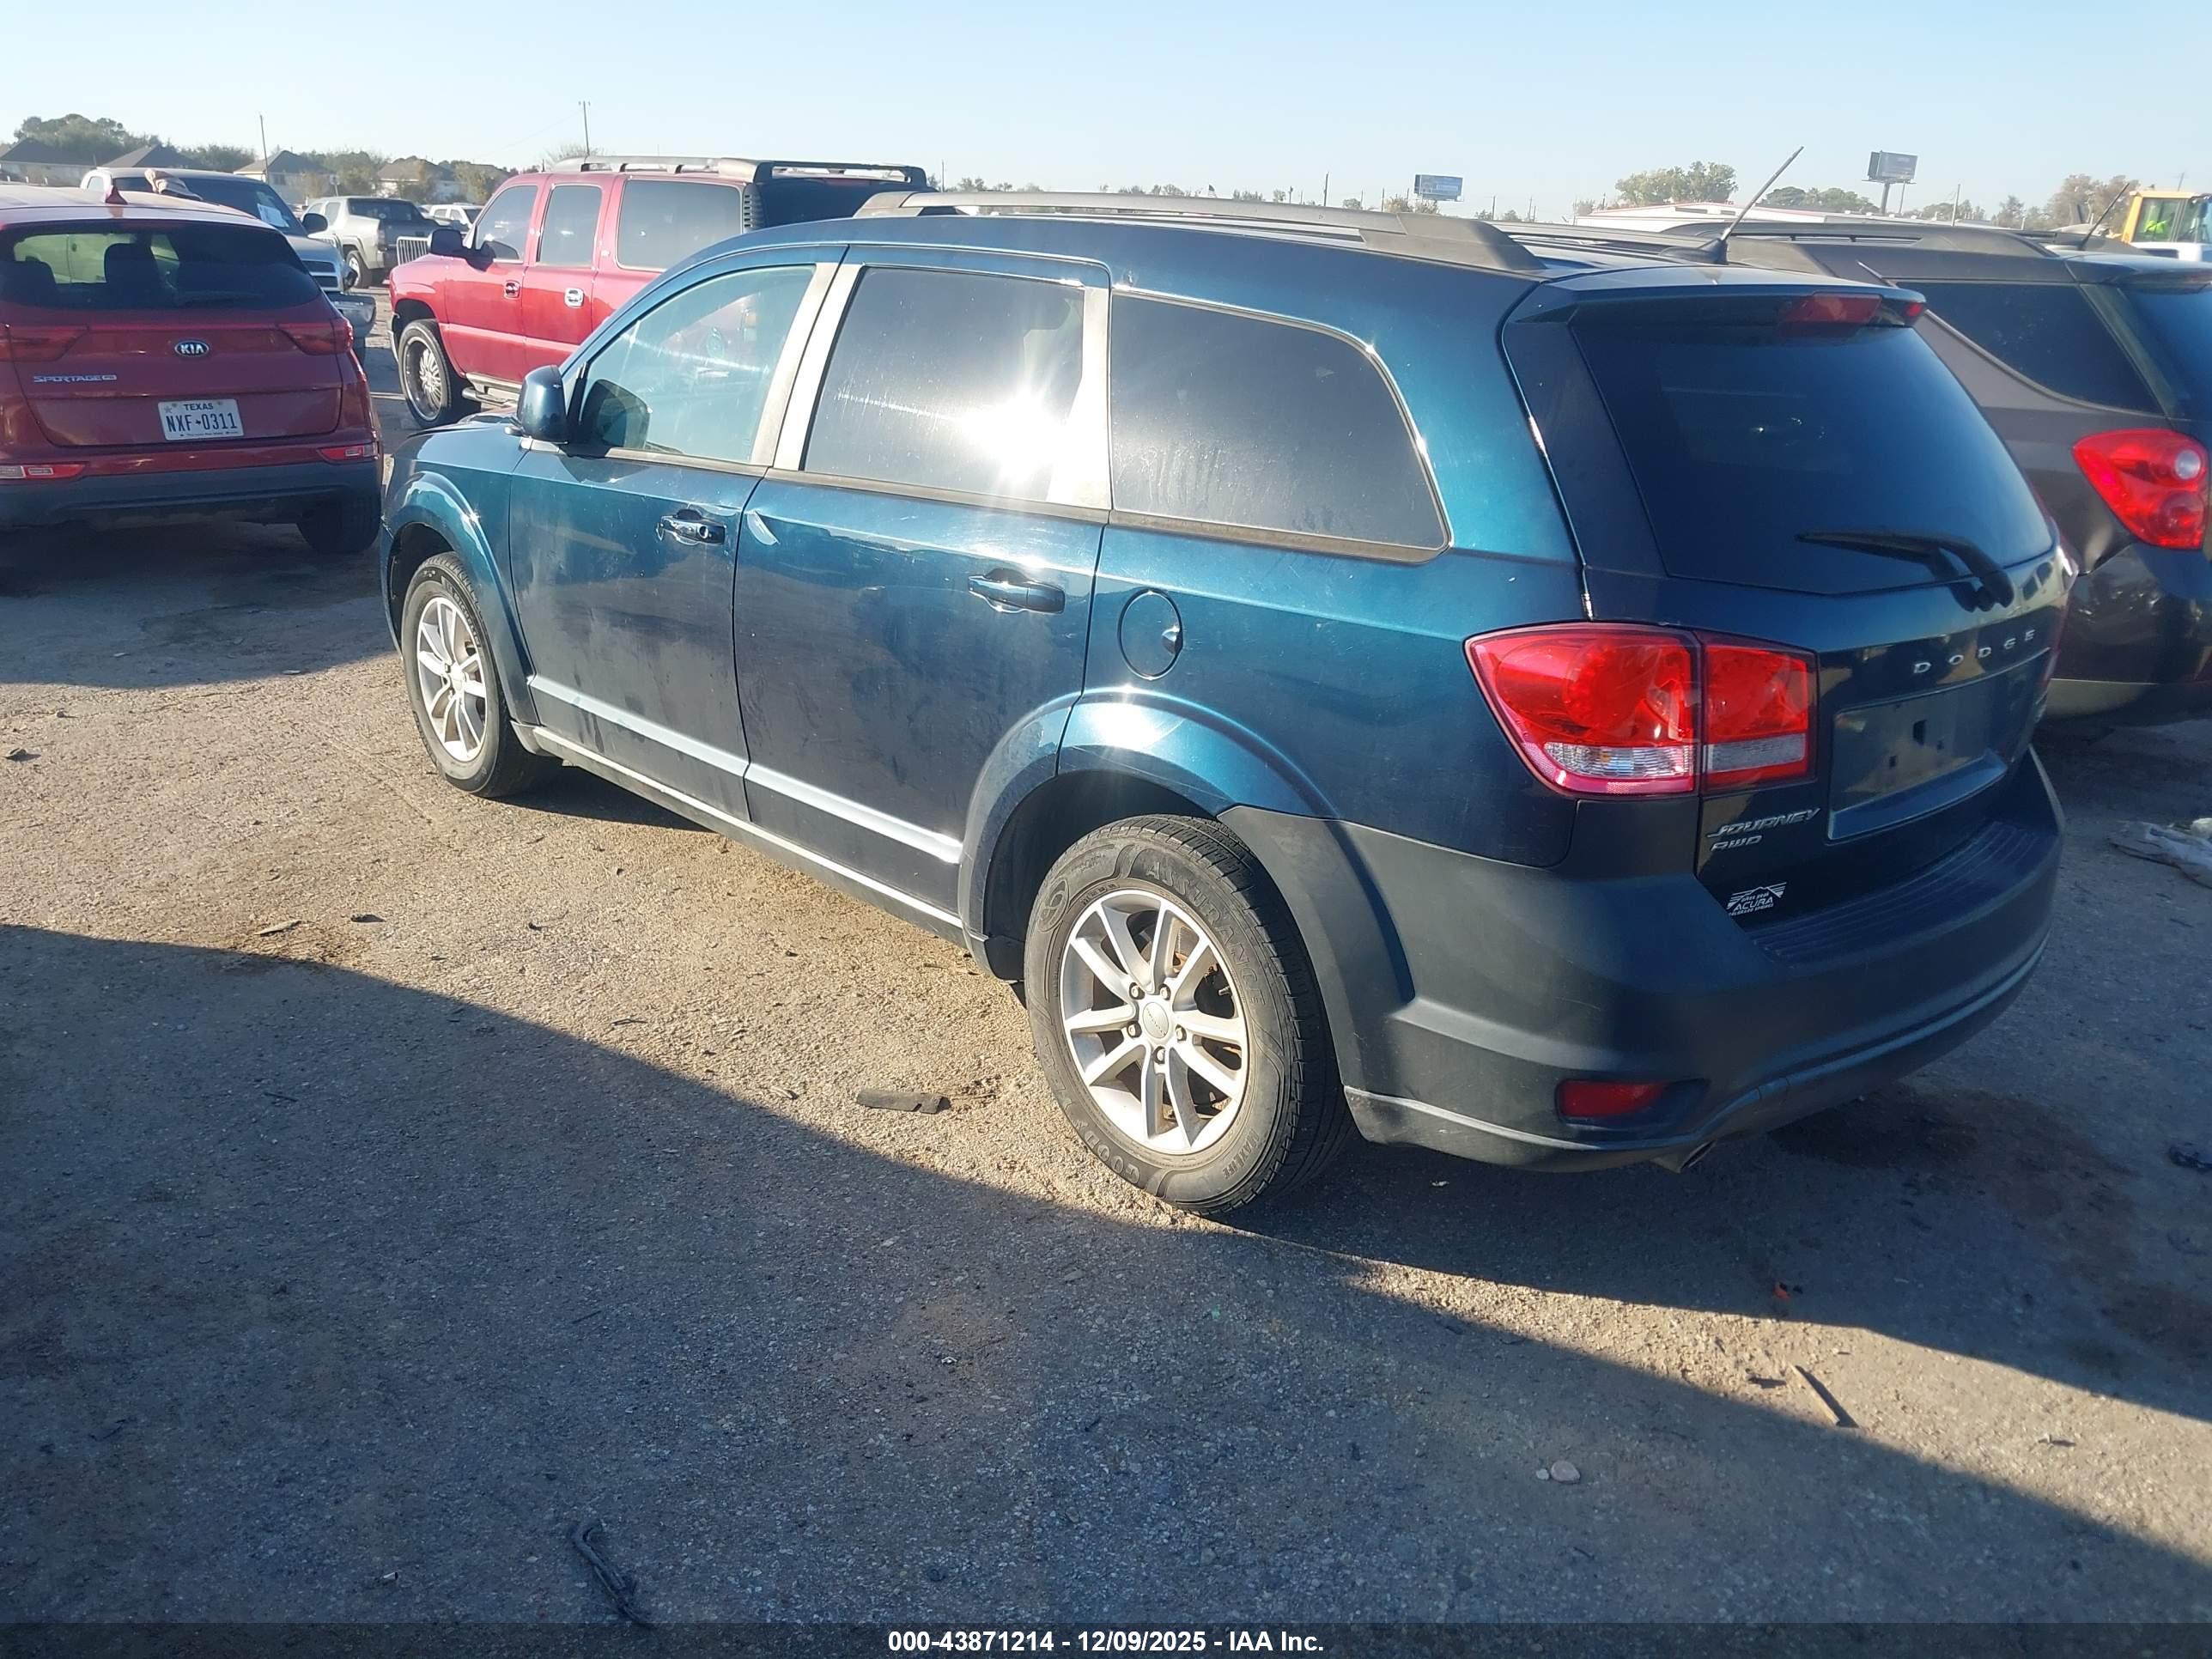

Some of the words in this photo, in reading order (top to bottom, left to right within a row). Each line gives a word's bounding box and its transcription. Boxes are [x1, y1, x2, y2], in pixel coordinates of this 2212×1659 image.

[179, 343, 204, 355] KIA
[33, 374, 102, 383] SPORTAGE
[184, 403, 214, 411] TEXAS
[1912, 629, 2036, 674] DODGE
[1707, 807, 1821, 838] JOURNEY
[1710, 835, 1762, 852] AWD
[1733, 896, 1774, 913] ACURA
[1146, 860, 1266, 1006] ASSURANCE
